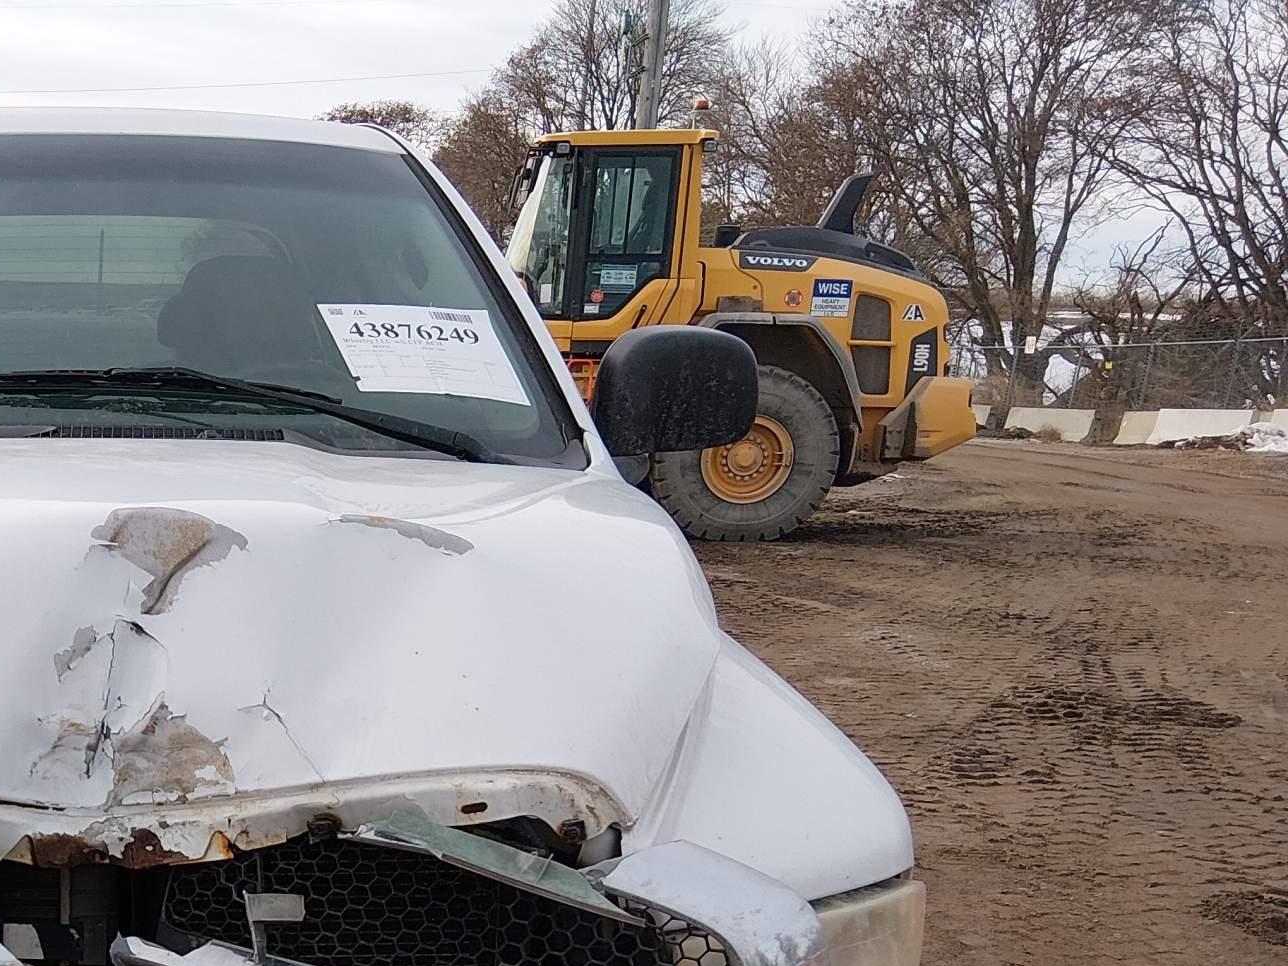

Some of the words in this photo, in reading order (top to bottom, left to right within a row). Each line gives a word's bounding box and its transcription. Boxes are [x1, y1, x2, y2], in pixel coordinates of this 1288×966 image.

[745, 256, 808, 267] VOLVO
[818, 282, 849, 295] WISE
[349, 322, 480, 345] 43876249
[912, 343, 931, 372] L90H
